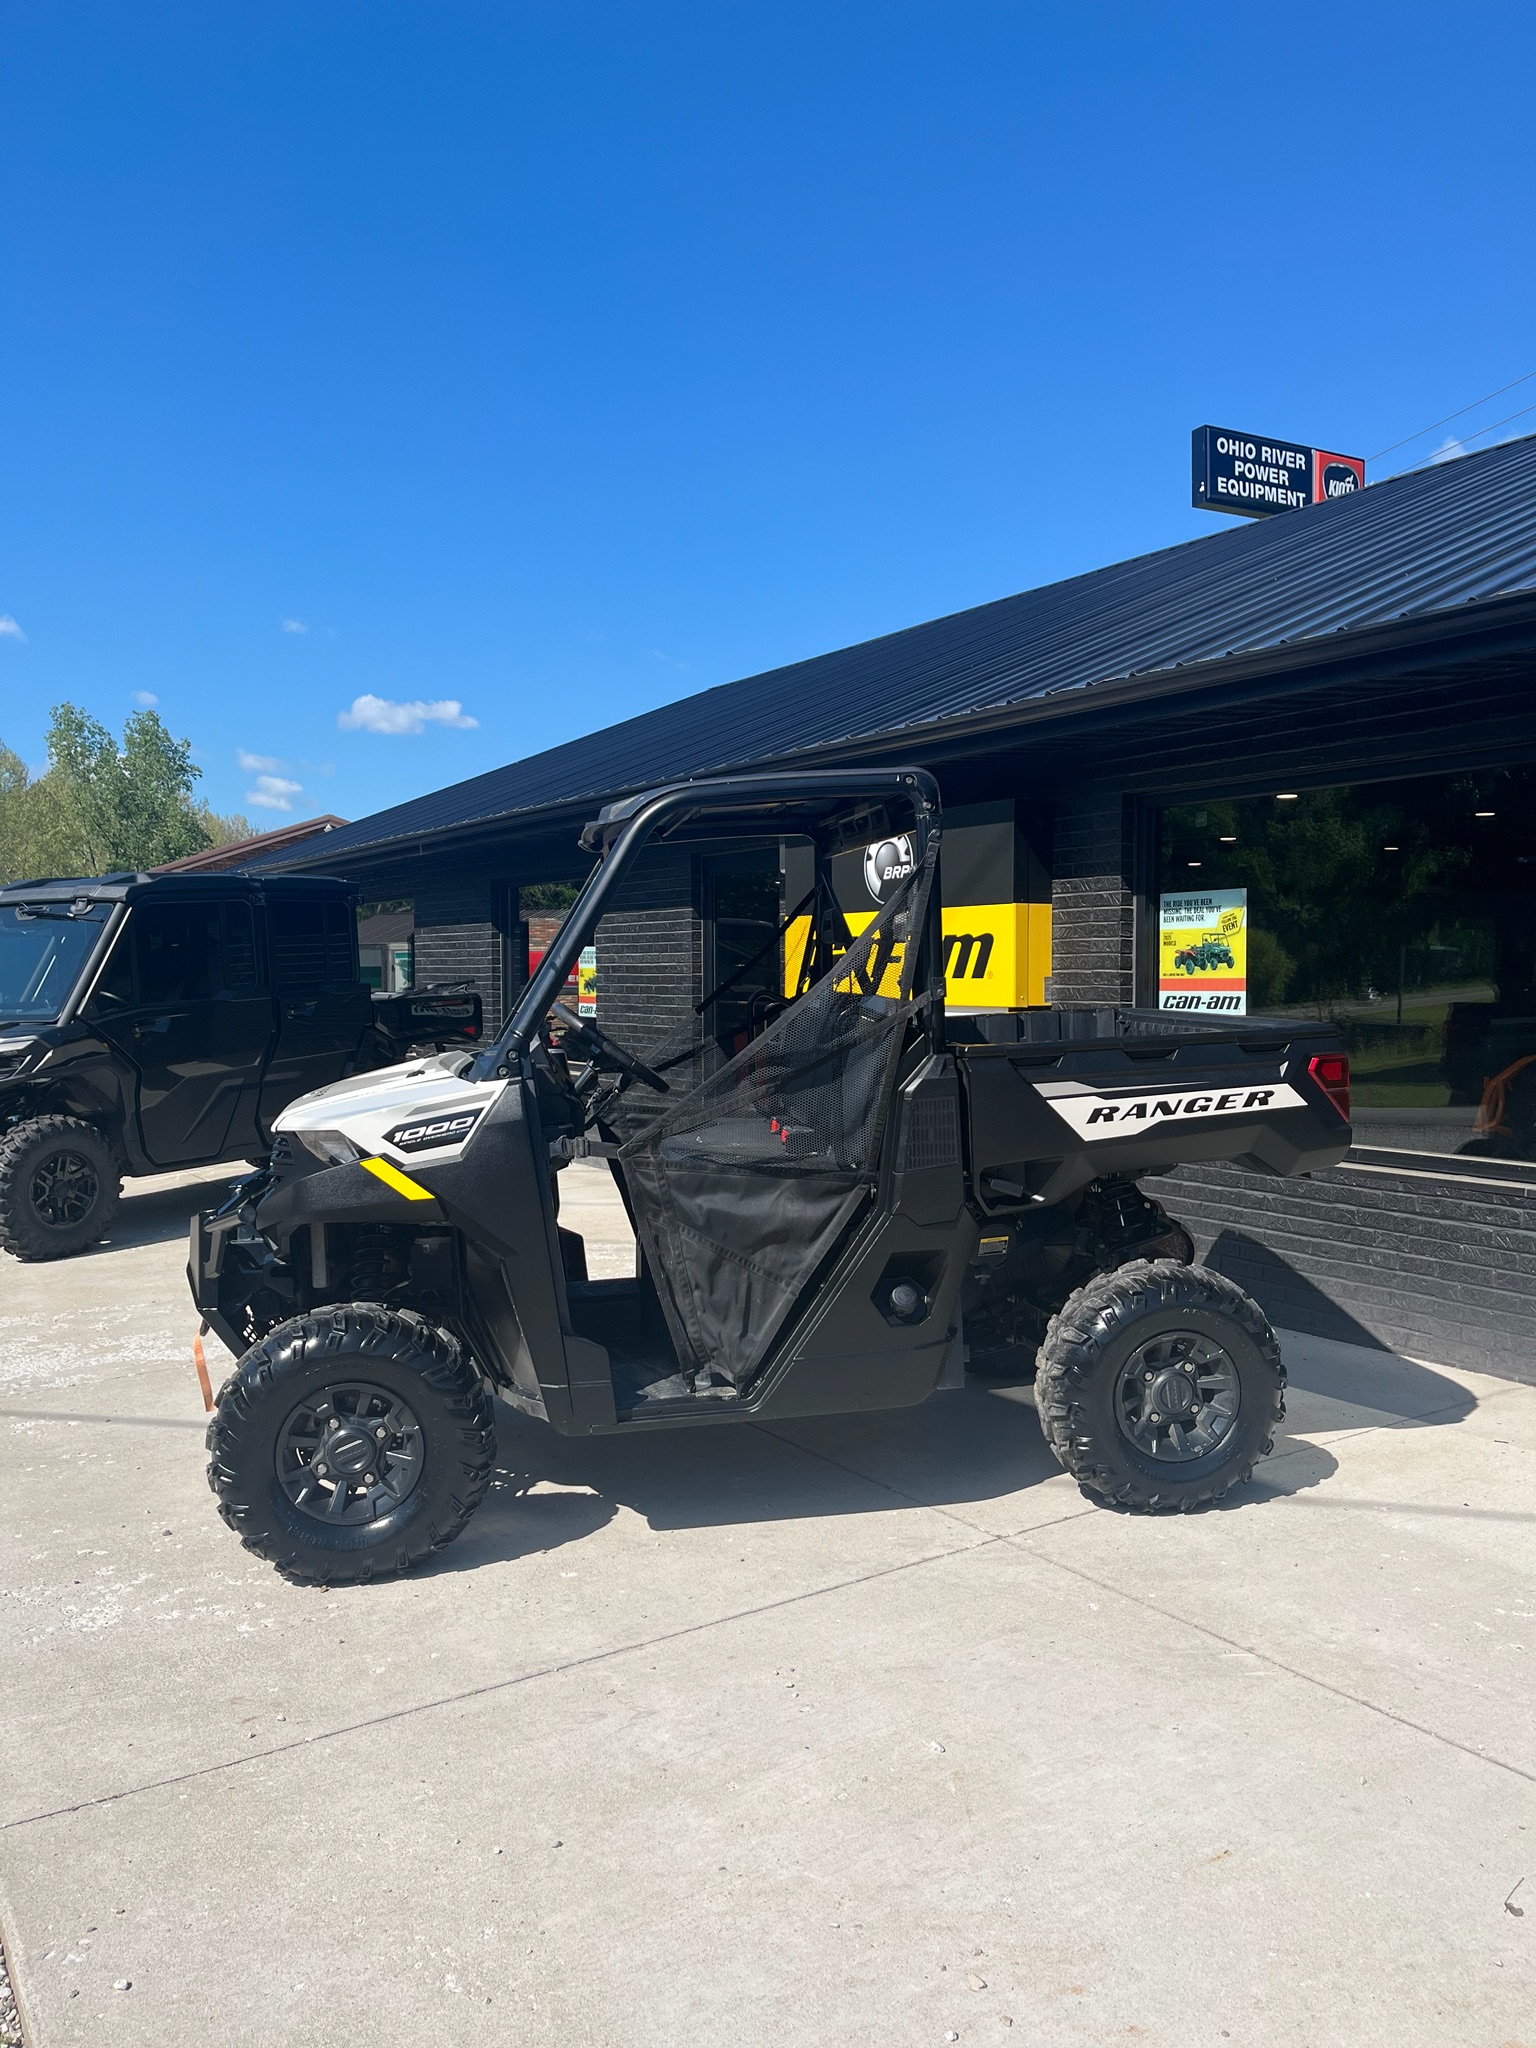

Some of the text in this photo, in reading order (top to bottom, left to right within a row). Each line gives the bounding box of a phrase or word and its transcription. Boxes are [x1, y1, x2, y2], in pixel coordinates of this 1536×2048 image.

[1216, 436, 1306, 471] OHIO RIVER
[1234, 460, 1289, 486] POWER
[1217, 476, 1306, 508] EQUIPMENT
[883, 864, 911, 880] BRP
[1163, 898, 1212, 908] THE RIDE YOU'VE BEEN
[1194, 906, 1205, 914] DEAL
[1163, 915, 1174, 923] BEEN
[1176, 914, 1195, 922] WAITING
[1222, 920, 1239, 932] EVENT
[1162, 995, 1242, 1010] can-am
[1085, 1089, 1276, 1125] RANGER
[392, 1116, 475, 1143] 1000
